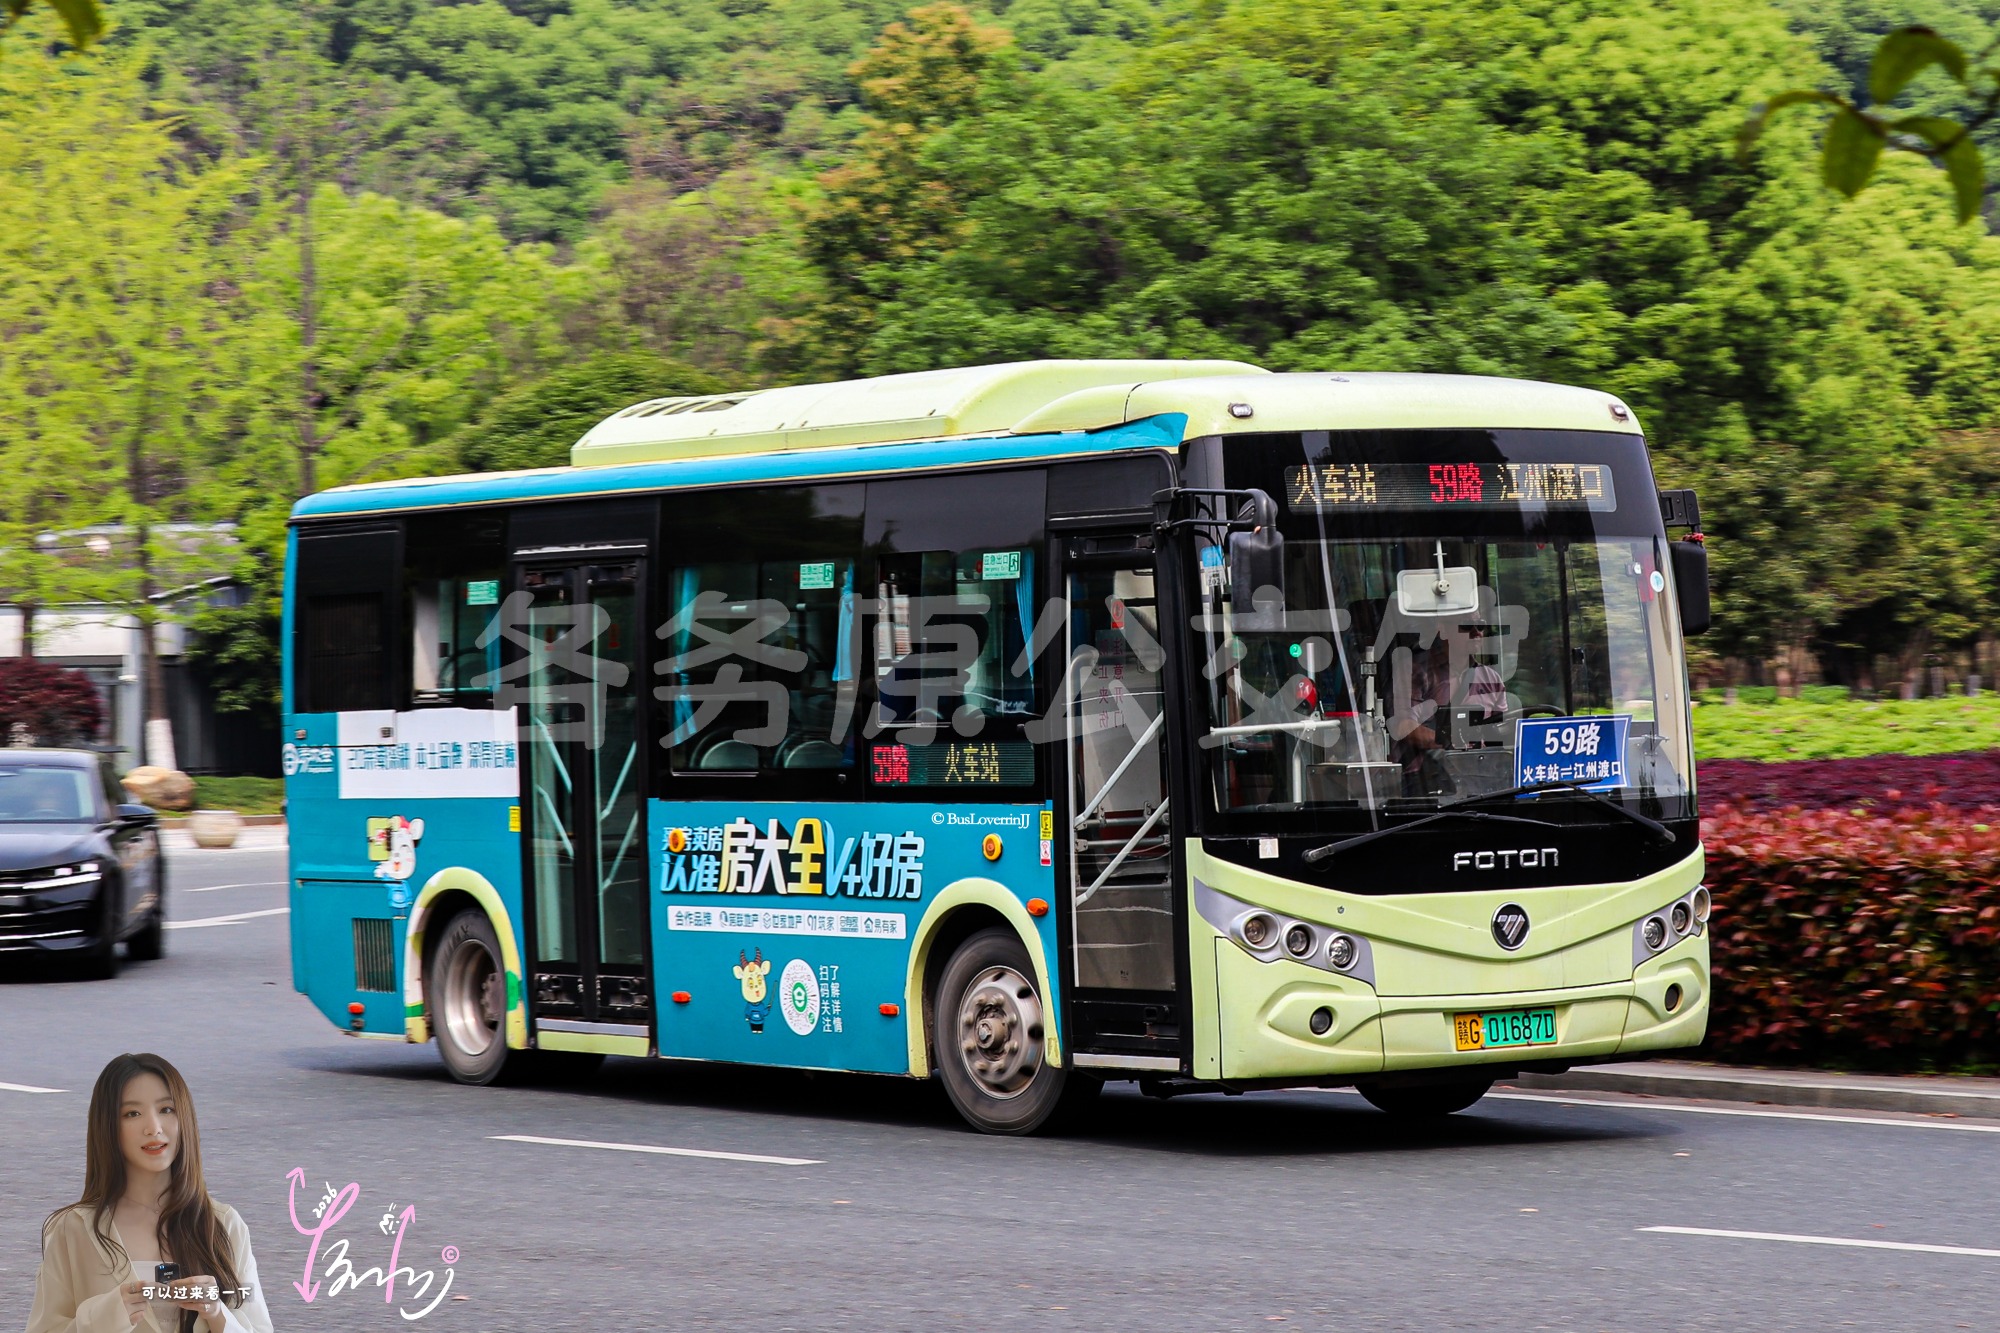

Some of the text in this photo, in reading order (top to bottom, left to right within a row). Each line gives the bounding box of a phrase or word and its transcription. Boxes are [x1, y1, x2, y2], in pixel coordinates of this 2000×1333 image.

[1294, 462, 1602, 503] 火车站 59路 江州渡口
[1544, 722, 1601, 755] 59路
[873, 743, 999, 782] 59路 火车站
[1522, 760, 1621, 783] 火车站 江州渡口
[660, 853, 721, 892] 认准
[718, 817, 825, 895] 房大全
[1454, 848, 1559, 871] FOTON
[675, 910, 713, 927] 合作品牌
[819, 965, 832, 1032] 扫码关注
[830, 965, 842, 1033] 了解详情
